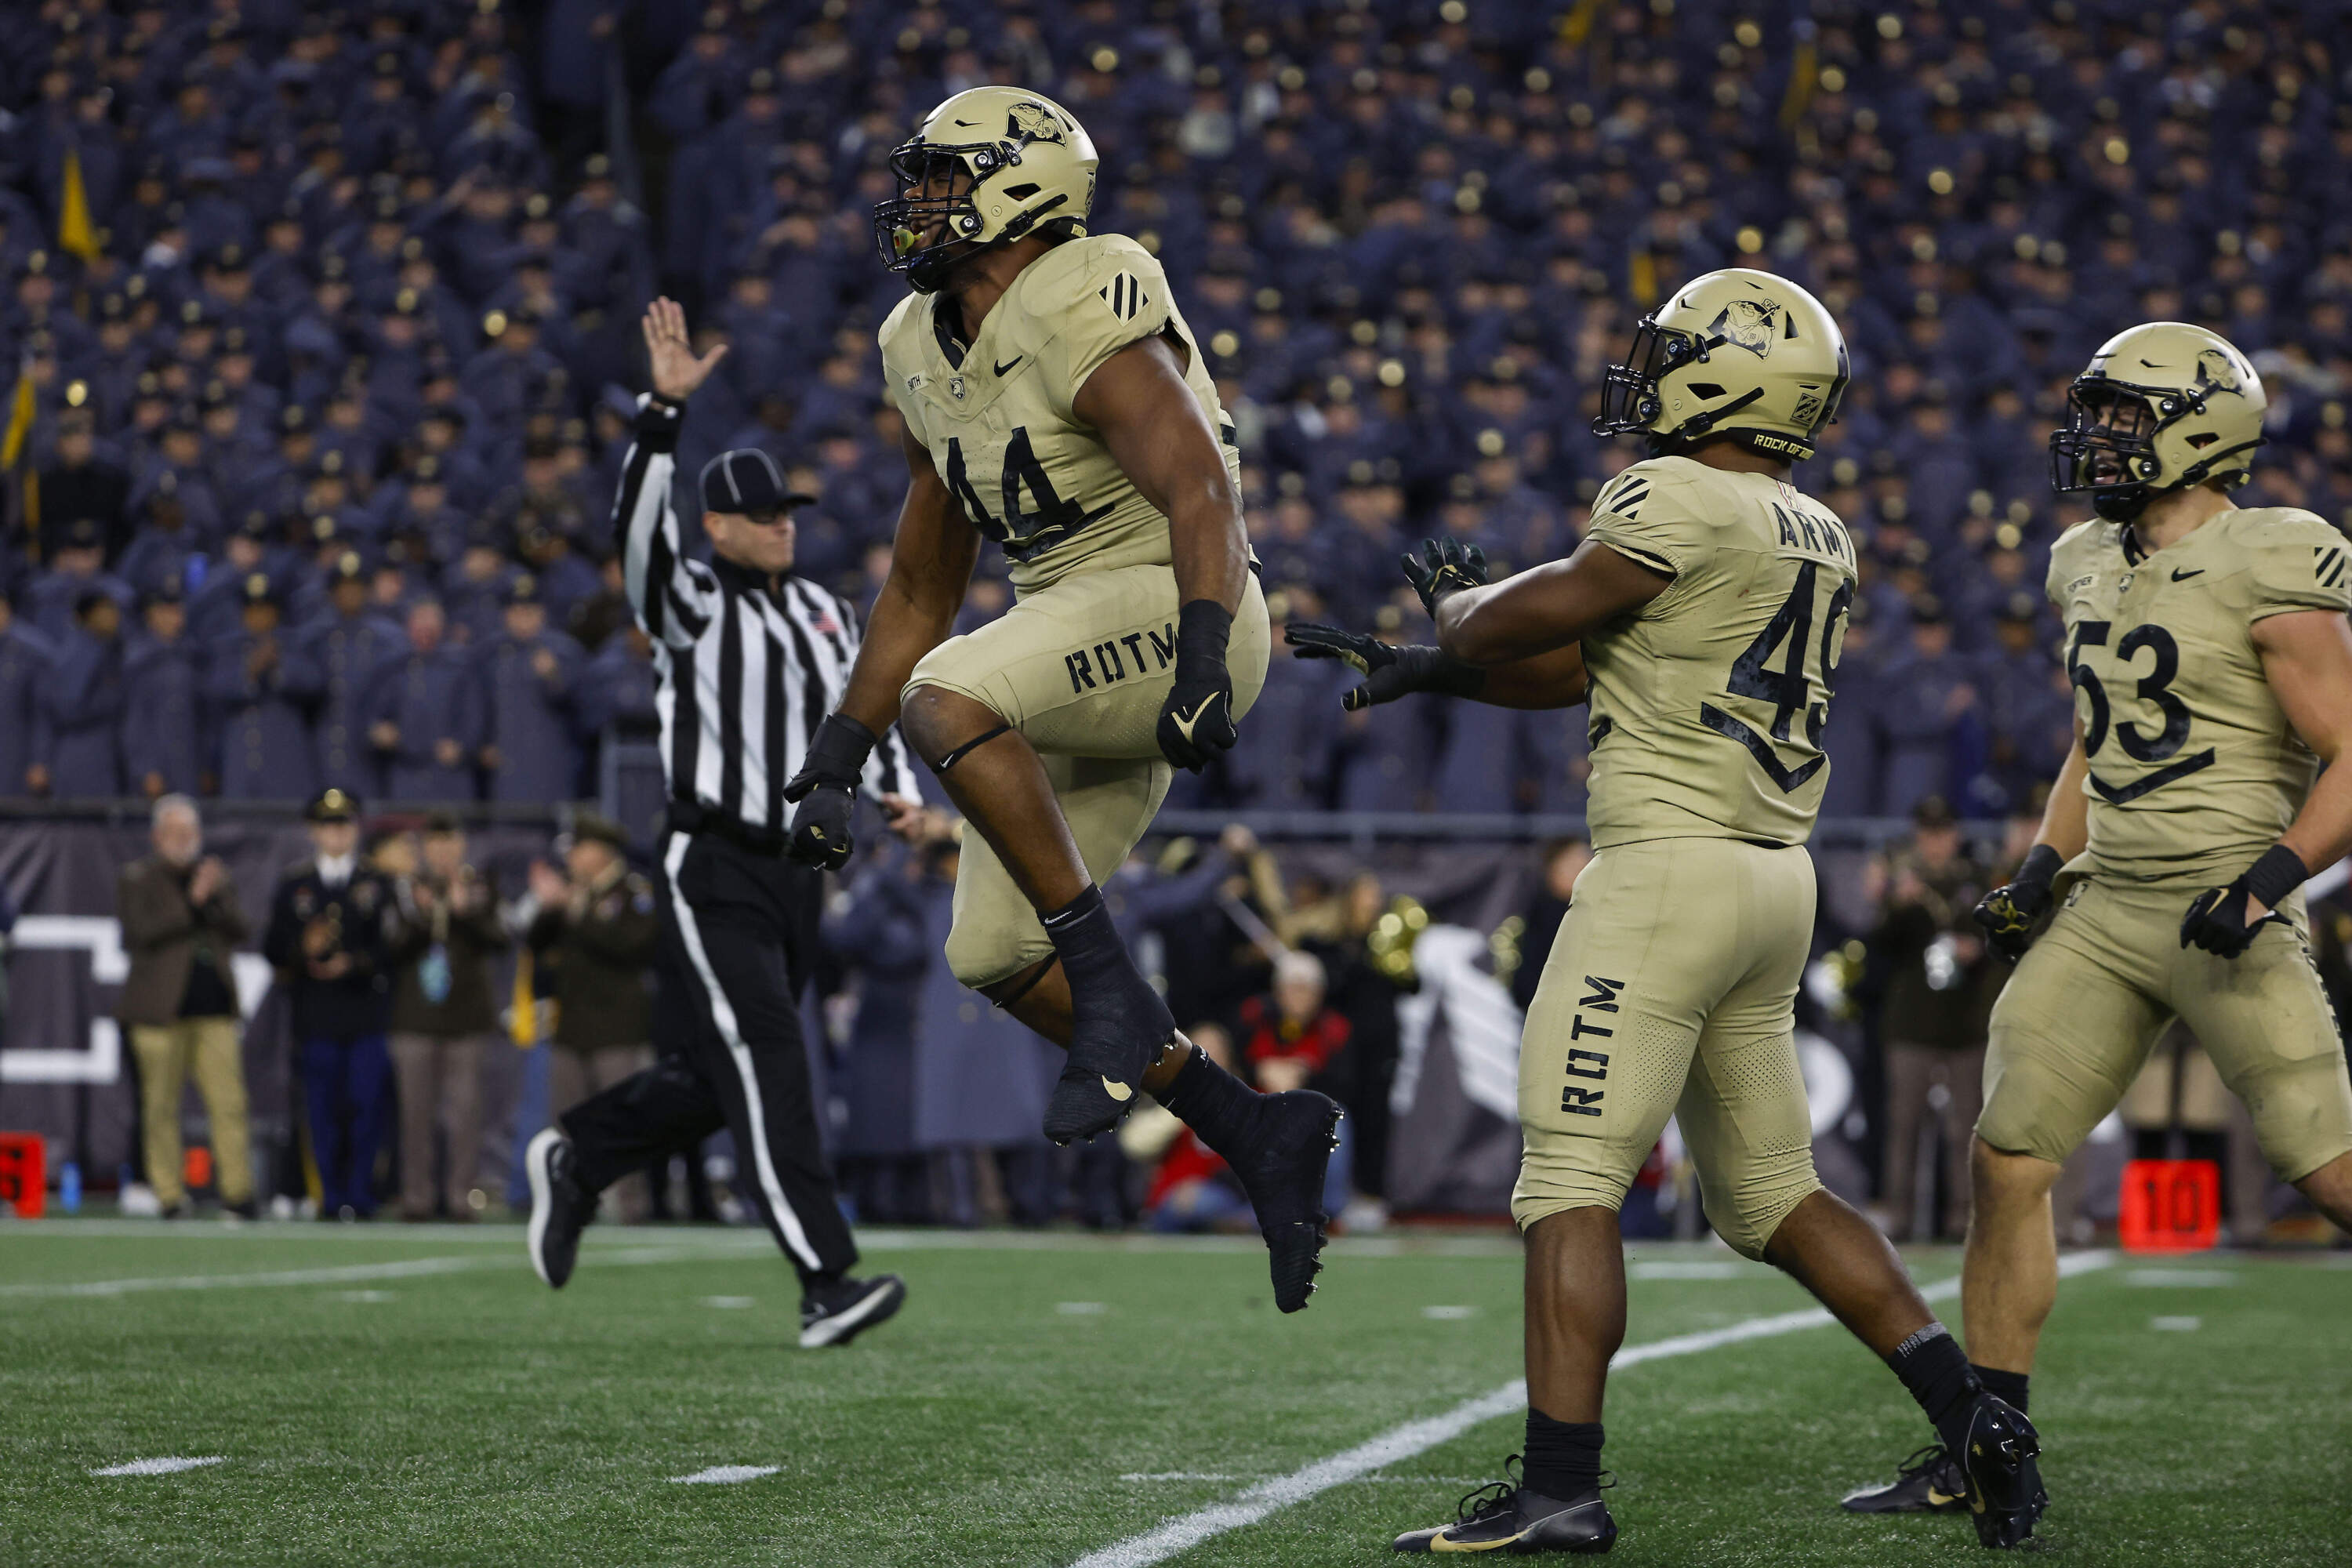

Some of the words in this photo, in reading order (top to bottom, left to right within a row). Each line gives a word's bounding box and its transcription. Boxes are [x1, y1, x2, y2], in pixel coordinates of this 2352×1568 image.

[947, 426, 1086, 543] 44
[1754, 434, 1788, 452] ROCK
[1787, 442, 1803, 455] OF
[1065, 622, 1178, 694] ROTM
[2068, 620, 2191, 762] 53
[1561, 975, 1625, 1116] ROTM
[2147, 1178, 2200, 1232] 10
